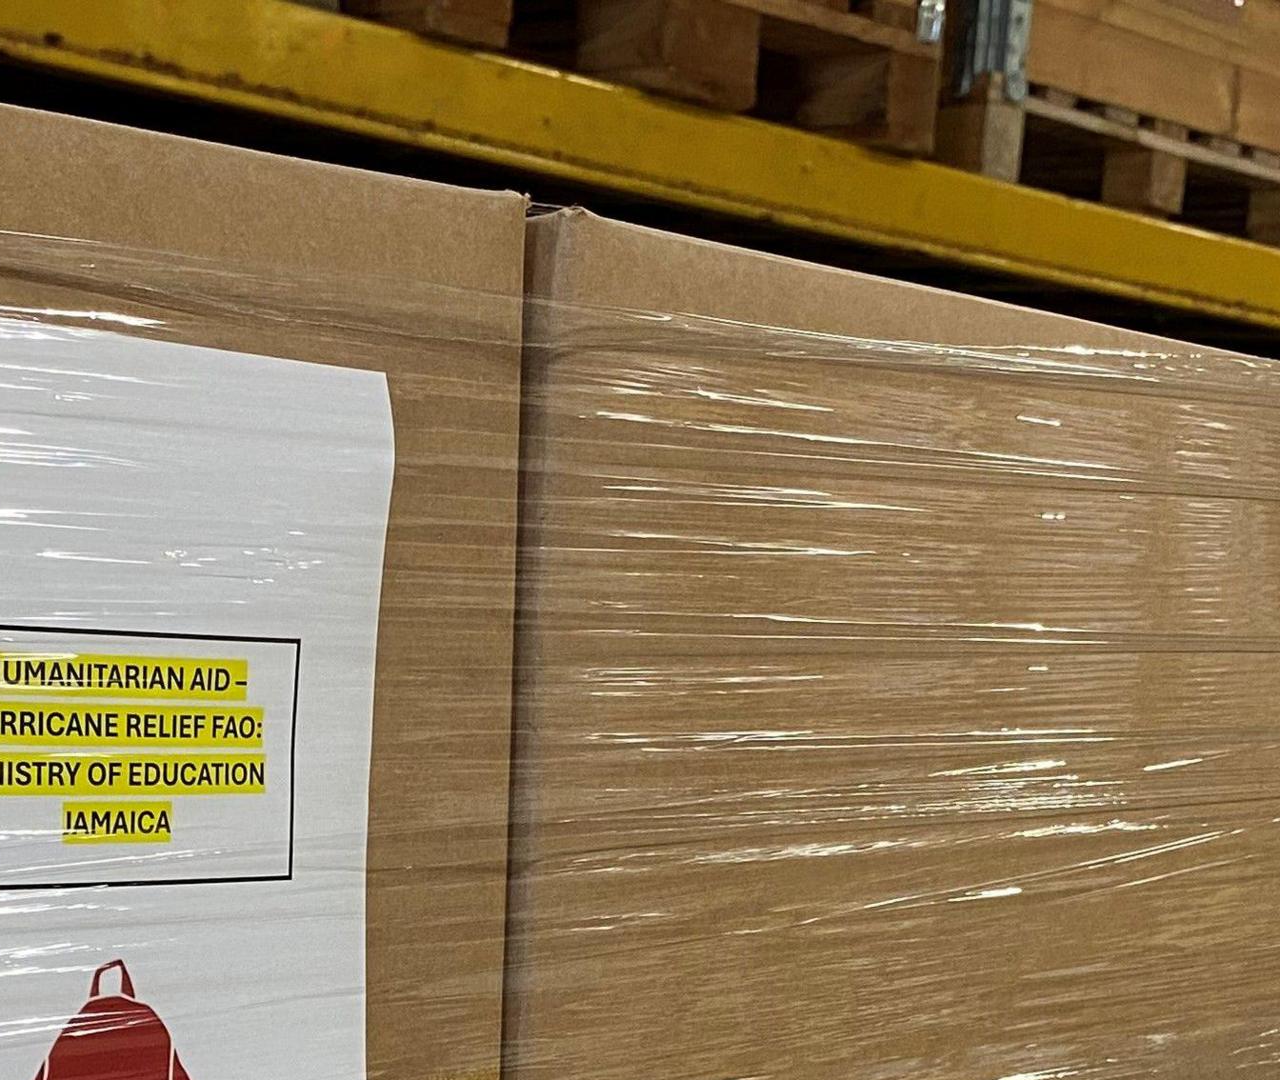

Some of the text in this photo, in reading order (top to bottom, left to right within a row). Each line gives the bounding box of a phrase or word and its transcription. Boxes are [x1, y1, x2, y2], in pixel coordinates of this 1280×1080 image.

[190, 667, 230, 692] AID
[126, 713, 205, 739] RELIEF
[211, 715, 262, 739] FAO:
[88, 761, 121, 787] OF
[128, 762, 265, 787] EDUCATION
[63, 810, 172, 837] JAMAICA
